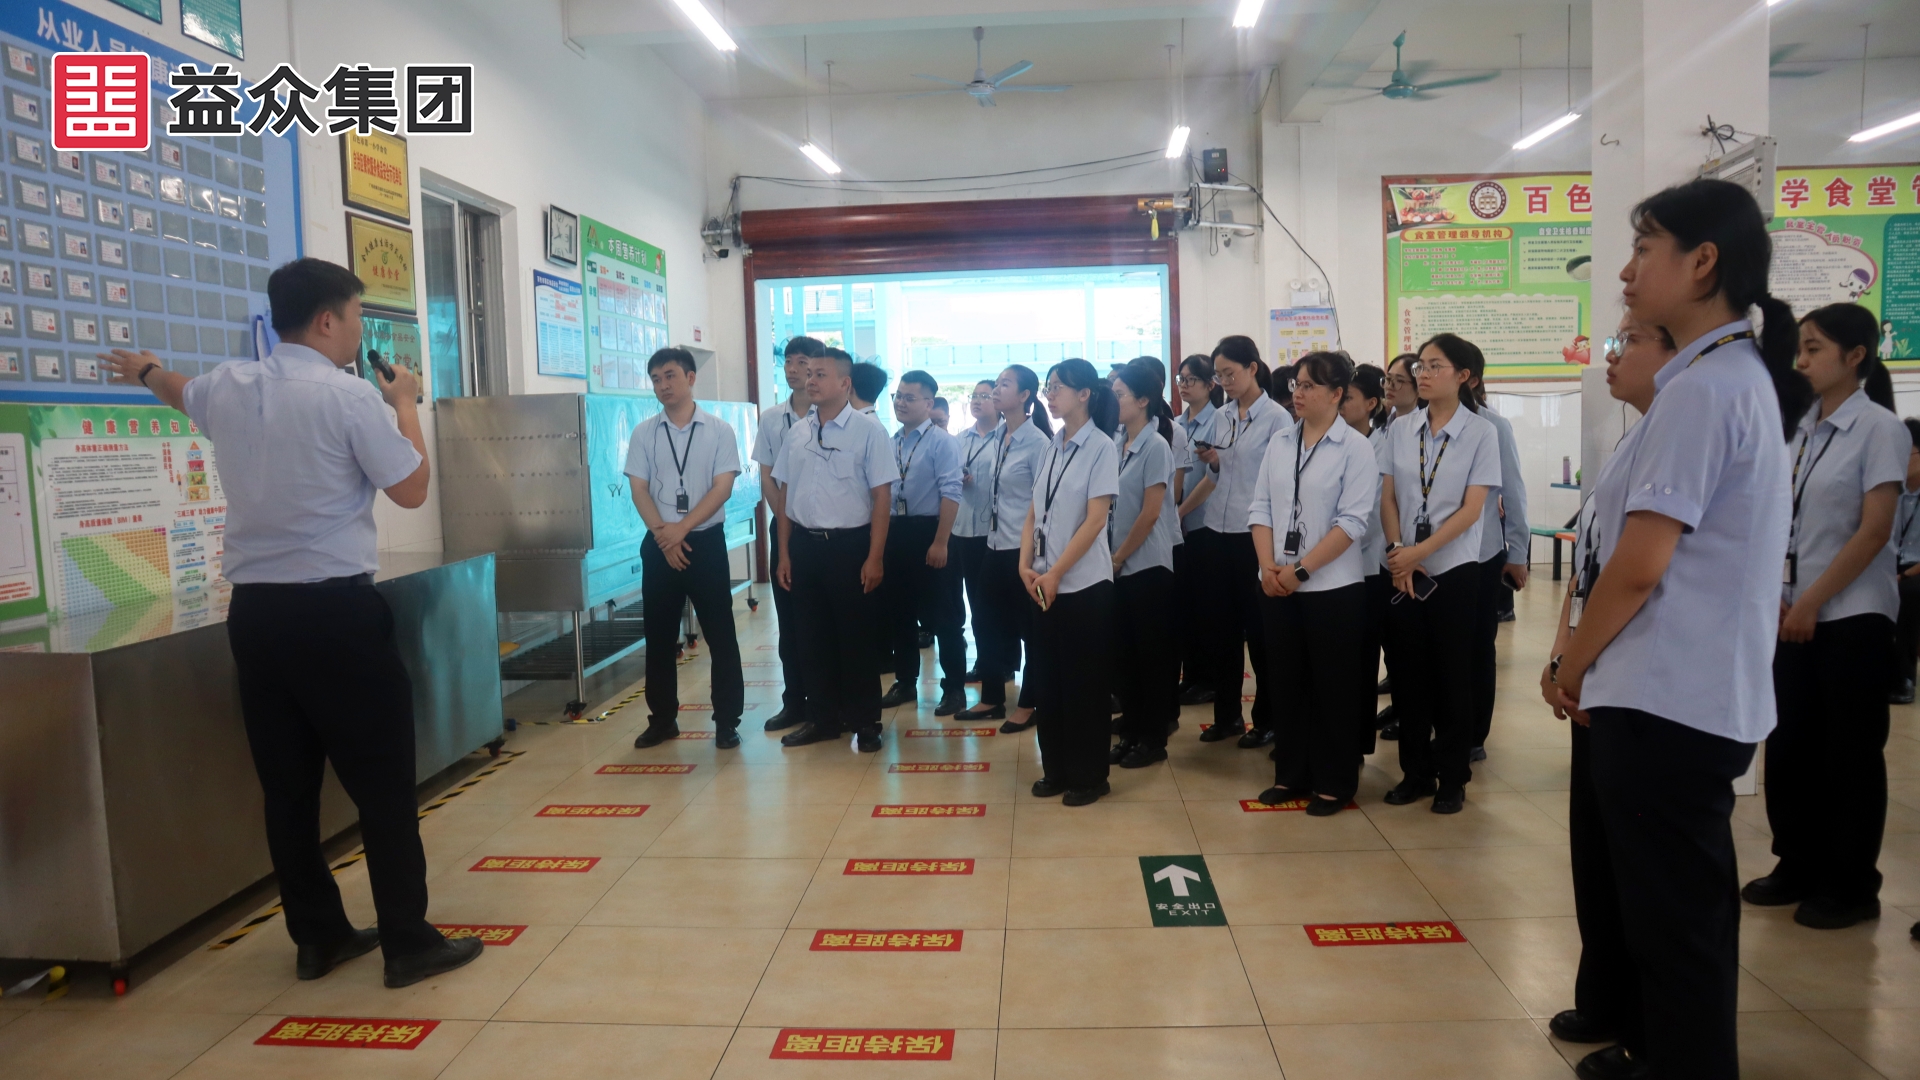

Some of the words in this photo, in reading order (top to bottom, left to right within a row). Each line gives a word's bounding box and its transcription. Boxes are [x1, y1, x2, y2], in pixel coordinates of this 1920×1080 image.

[1523, 184, 1592, 214] 百色
[1414, 229, 1503, 240] 食堂管理领导机构
[608, 238, 647, 267] 本周营养计划
[82, 419, 198, 435] 健康营养知识
[545, 806, 643, 816] 保持距离
[878, 806, 980, 816] 保持距离
[480, 857, 592, 871] 保持距离
[852, 861, 968, 873] 保持距离
[1155, 902, 1216, 911] 安全出口
[820, 933, 955, 948] 保持距离
[1315, 924, 1455, 943] 保持距离
[269, 1021, 425, 1045] 保持距离
[782, 1034, 946, 1055] 保持距离
